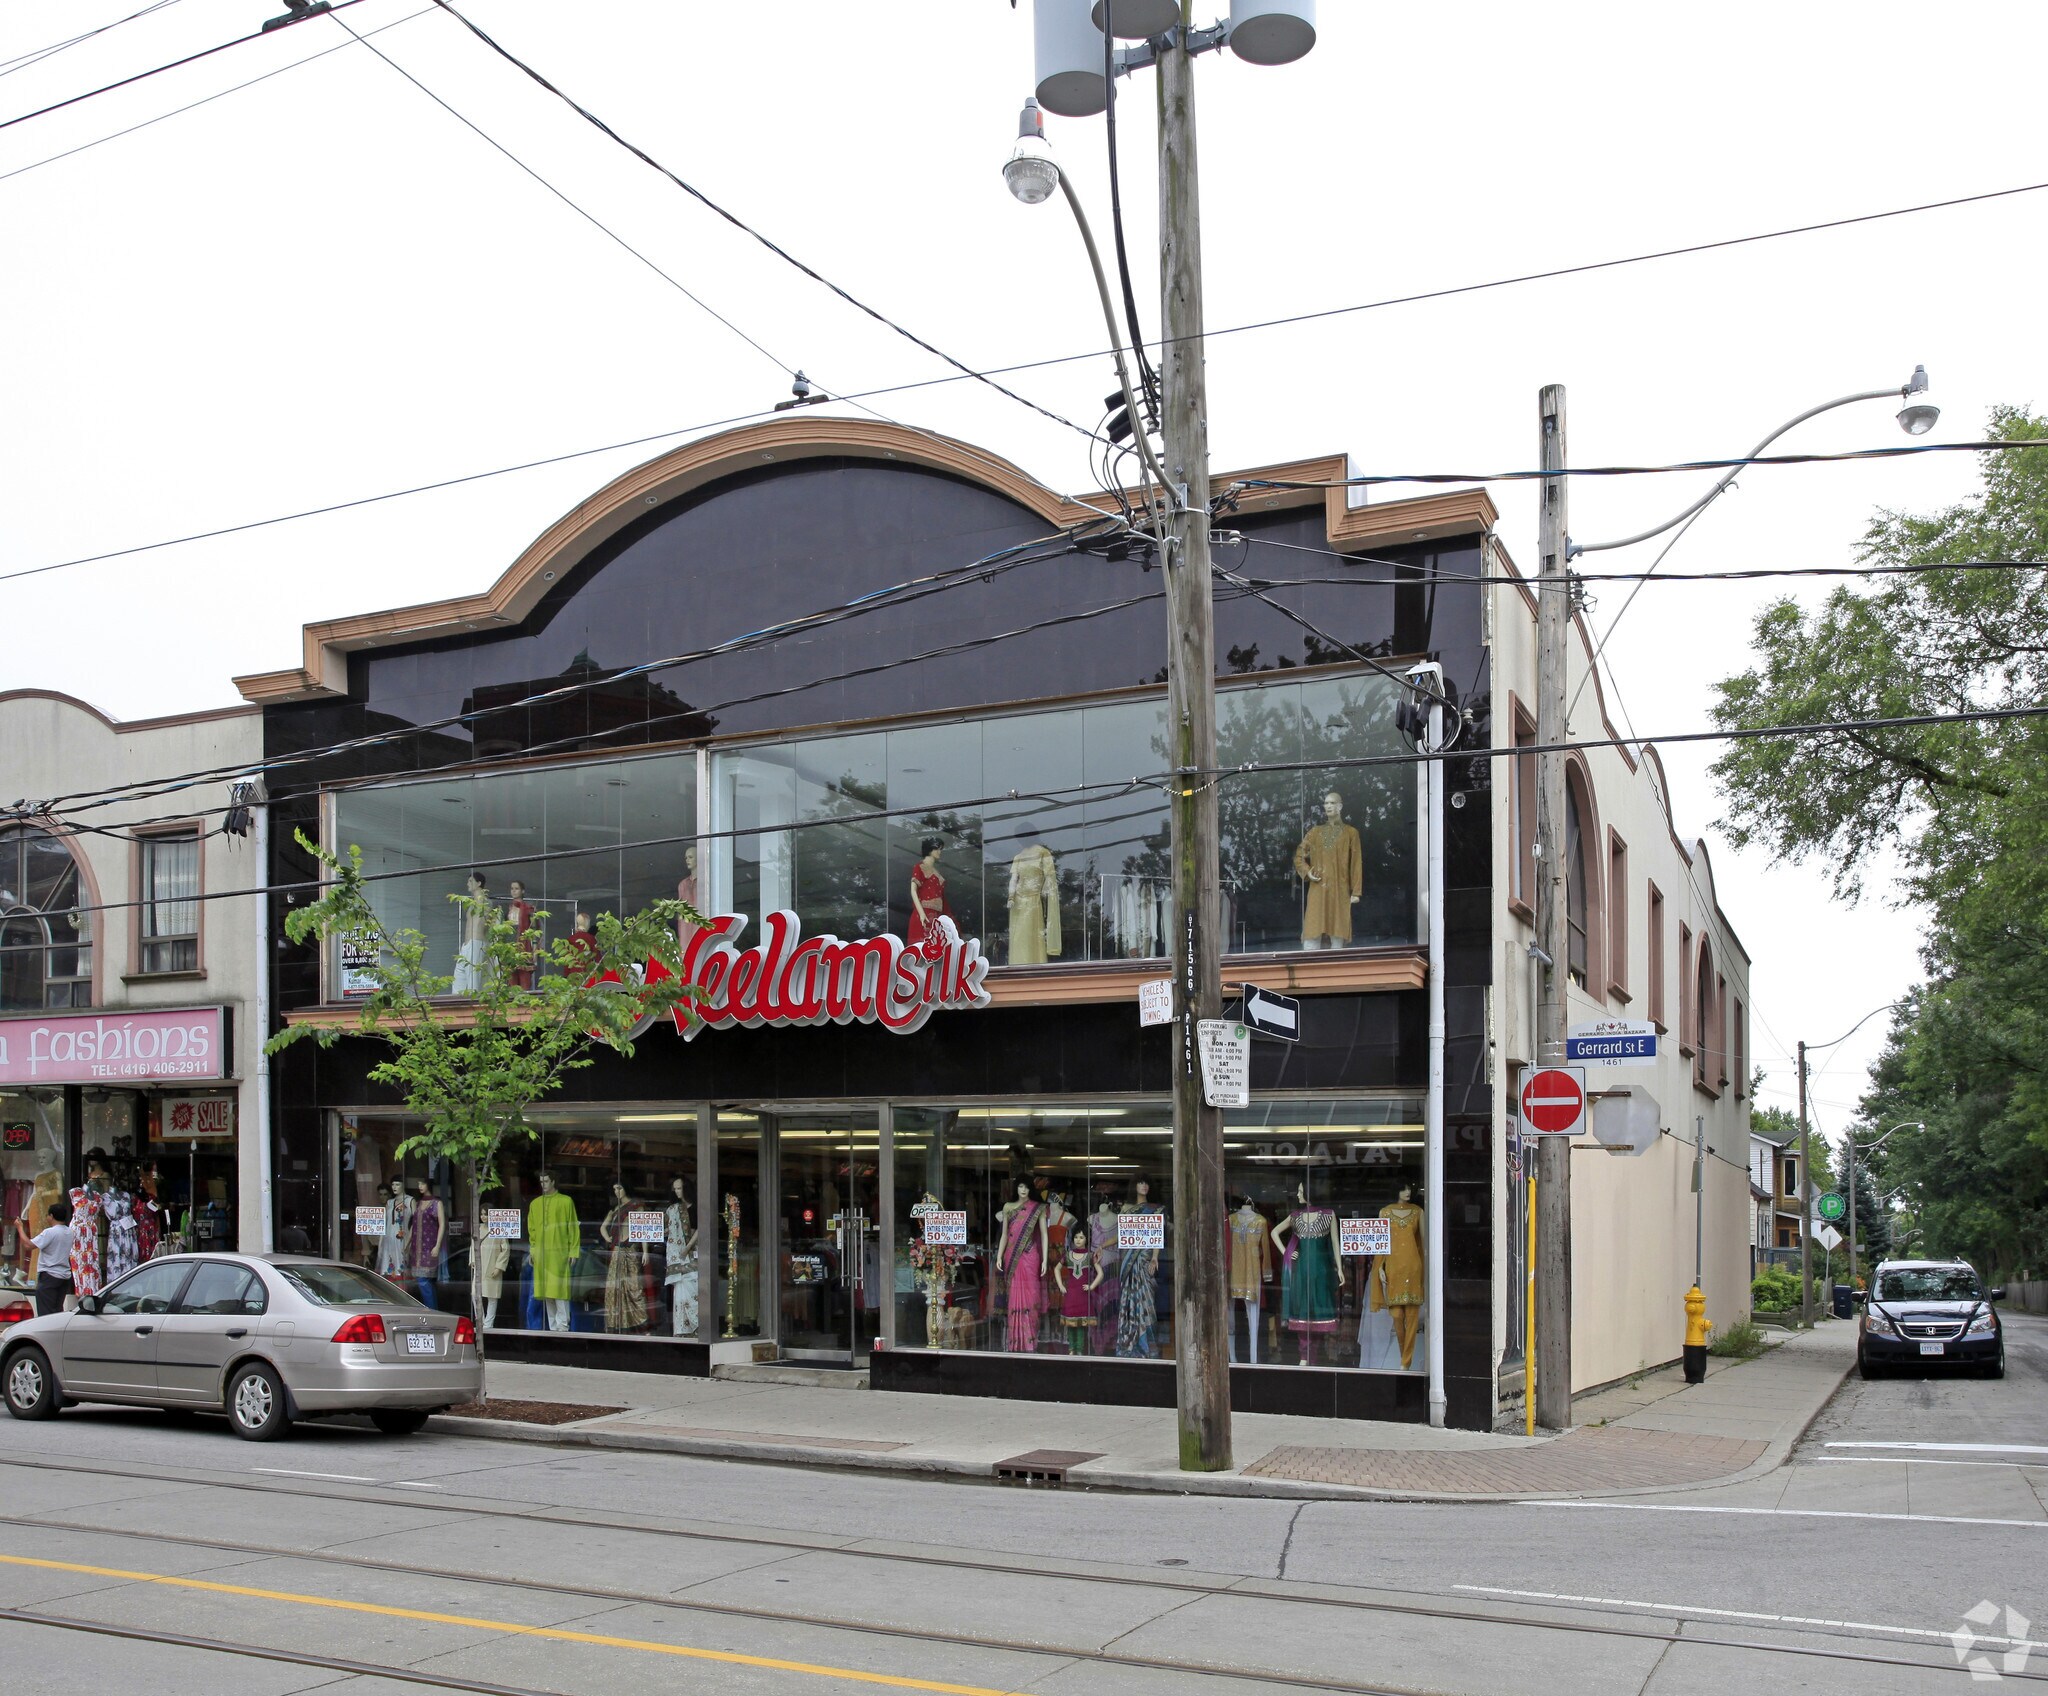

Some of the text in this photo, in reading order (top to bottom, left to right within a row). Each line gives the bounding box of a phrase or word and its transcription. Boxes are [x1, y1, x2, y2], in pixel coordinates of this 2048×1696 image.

[1160, 996, 1169, 1006] TO
[1577, 1039, 1644, 1055] Gerrard St E
[91, 1060, 208, 1076] TEL: (416) 406-2911
[178, 1113, 190, 1126] OUT
[198, 1100, 228, 1132] SALE
[4, 1130, 30, 1142] OPEN
[927, 1232, 950, 1240] 50%
[1120, 1237, 1146, 1245] 50%
[1343, 1242, 1371, 1251] 50%
